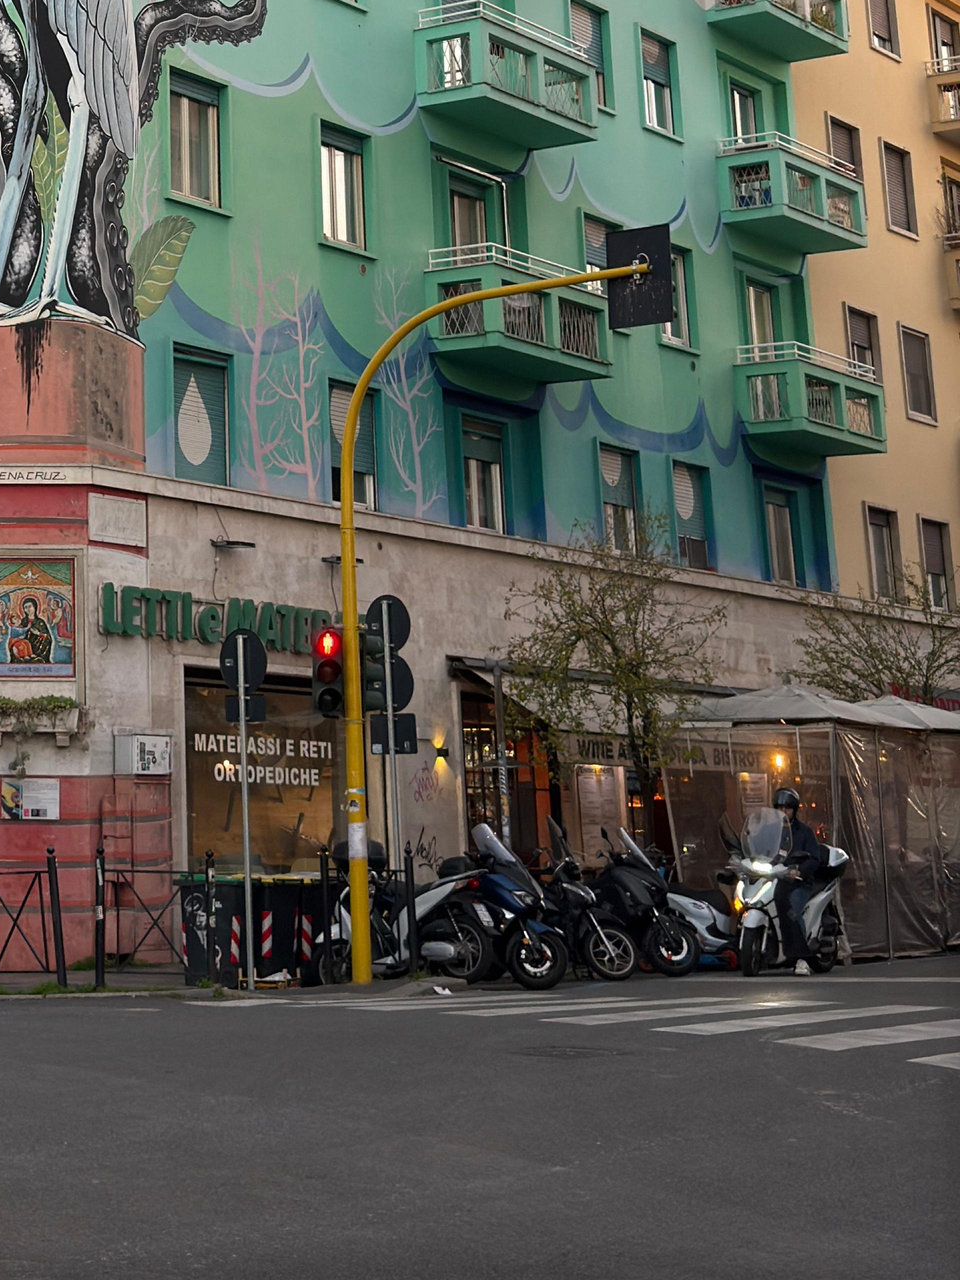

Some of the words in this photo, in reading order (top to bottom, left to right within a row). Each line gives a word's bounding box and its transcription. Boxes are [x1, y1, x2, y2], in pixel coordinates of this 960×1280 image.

[98, 582, 192, 641] LETTI
[196, 604, 222, 644] e
[286, 738, 295, 757] E
[299, 739, 333, 759] RETI
[213, 762, 320, 787] ORTOPEDICHE
